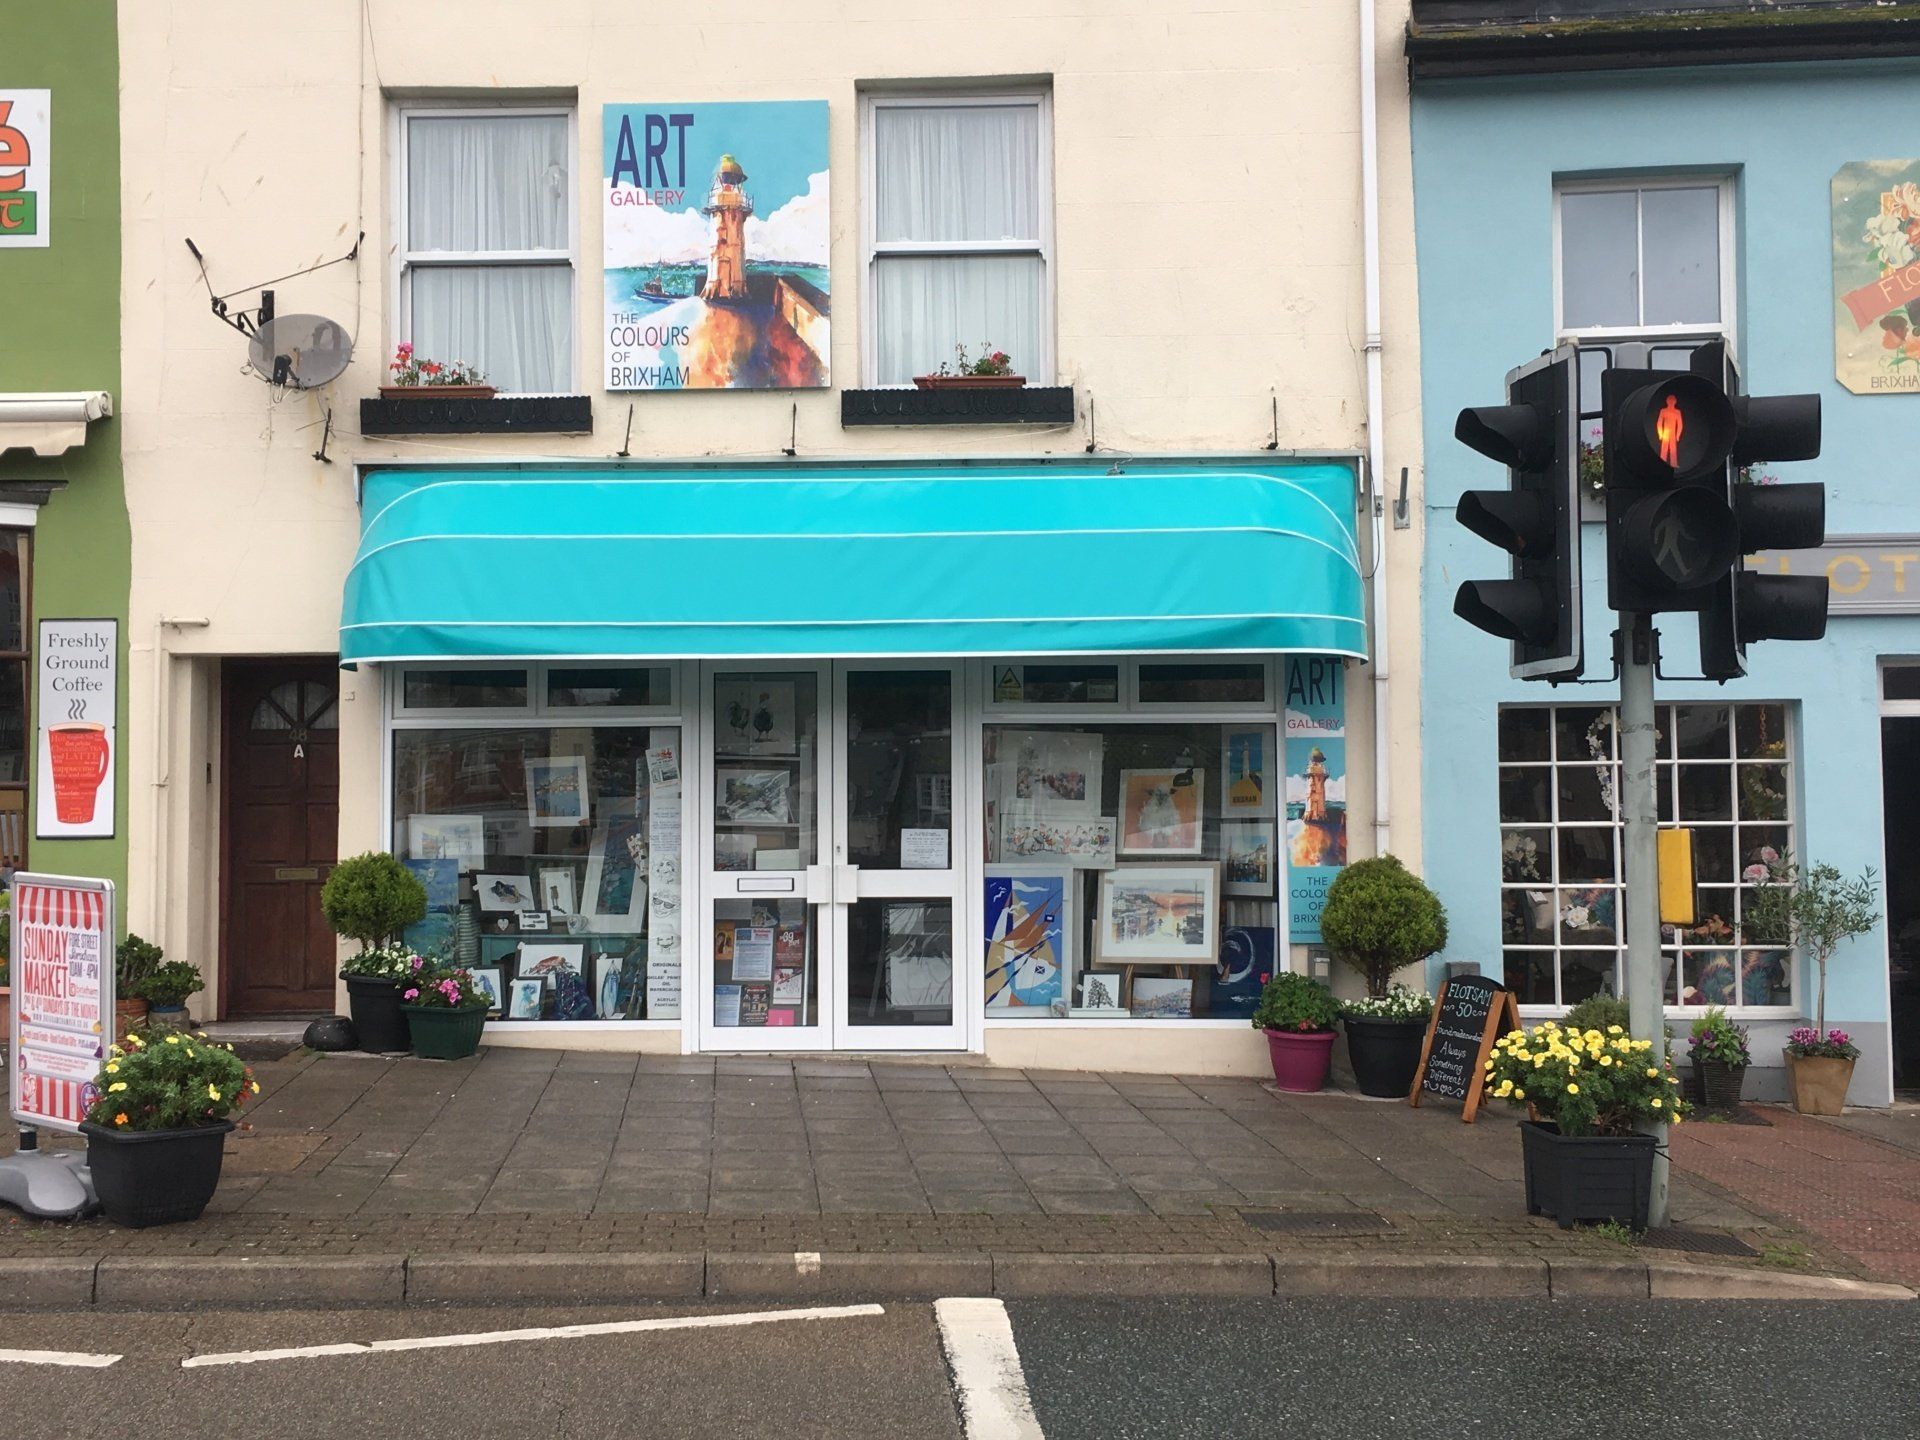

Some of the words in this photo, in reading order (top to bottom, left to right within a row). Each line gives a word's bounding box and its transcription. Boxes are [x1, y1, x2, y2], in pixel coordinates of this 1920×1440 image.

[611, 113, 694, 189] ART
[610, 190, 686, 206] GALLERY
[612, 313, 639, 324] THE
[610, 326, 690, 347] COLOURS
[611, 351, 631, 363] OF
[611, 366, 690, 386] BRIXHAM
[48, 632, 109, 653] Freshly
[46, 654, 109, 670] Ground
[52, 676, 103, 692] Coffee
[1286, 657, 1342, 705] ART
[1287, 719, 1340, 729] GALLERY
[293, 744, 305, 758] A
[1306, 876, 1328, 886] THE
[1308, 901, 1324, 911] OF
[24, 926, 69, 964] SUNDAY
[81, 933, 98, 950] STREET
[69, 960, 83, 978] 10AM
[87, 963, 98, 979] 4PM
[24, 960, 68, 999] MARKET
[1447, 982, 1493, 1007] FLOTSAM
[1455, 1002, 1473, 1017] 50
[1440, 1040, 1467, 1060] Always
[1429, 1055, 1463, 1076] Something
